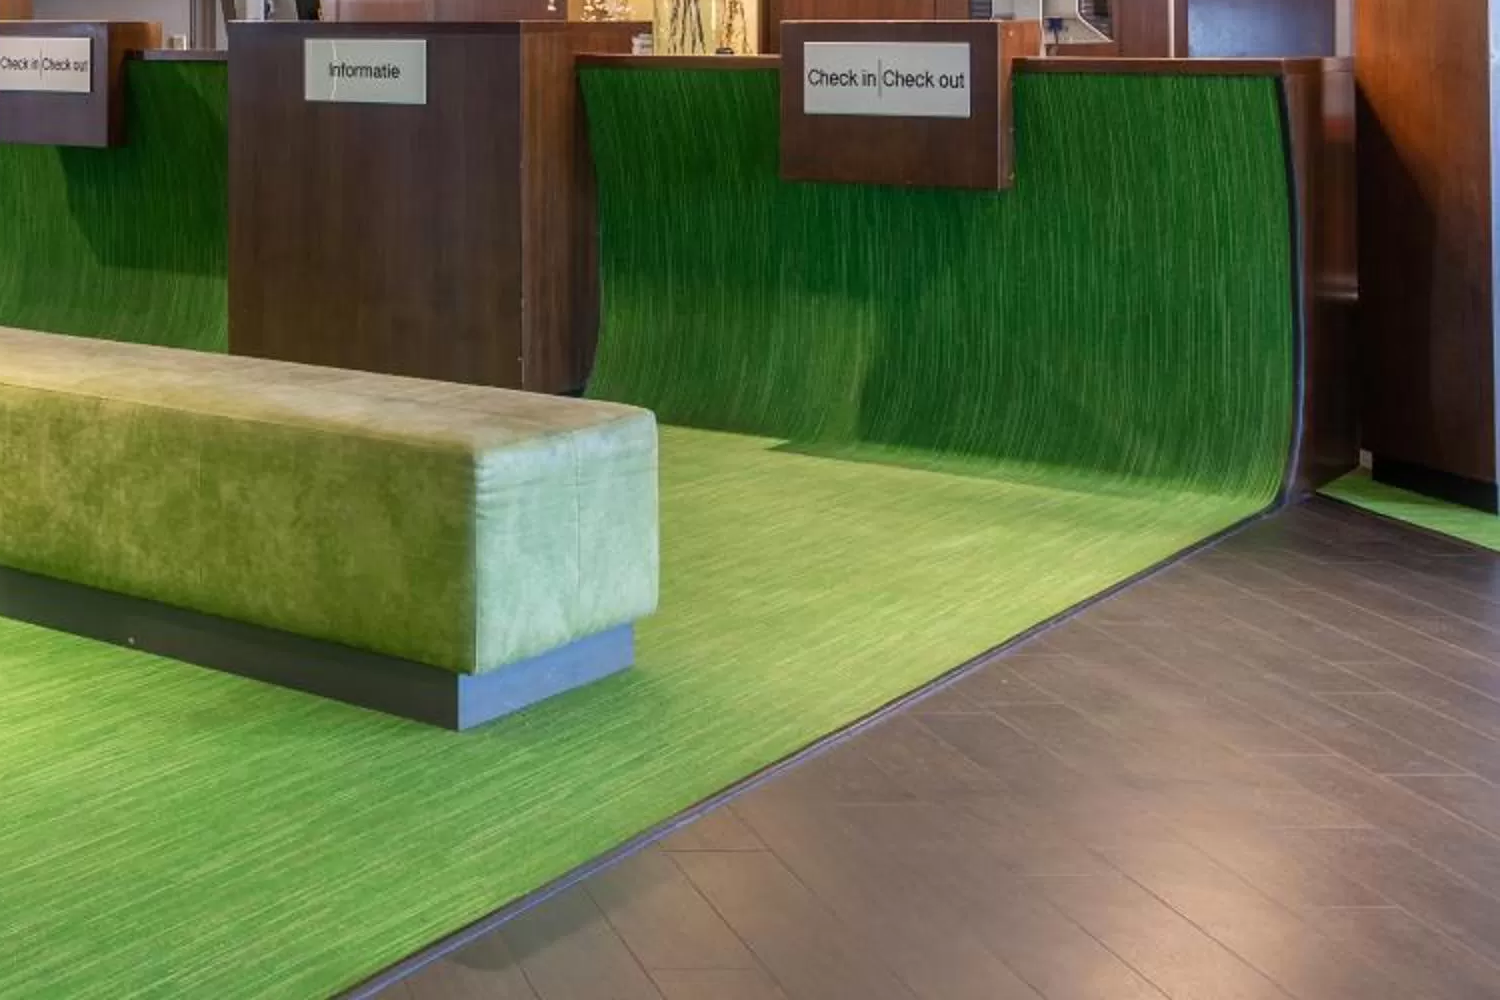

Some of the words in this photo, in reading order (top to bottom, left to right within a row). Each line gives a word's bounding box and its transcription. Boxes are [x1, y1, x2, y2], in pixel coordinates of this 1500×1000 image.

[0, 56, 28, 71] Check
[42, 57, 71, 71] Check
[328, 62, 401, 79] Informatie
[808, 68, 859, 87] Check
[861, 69, 876, 87] in
[883, 69, 934, 88] Check
[938, 72, 965, 89] out
